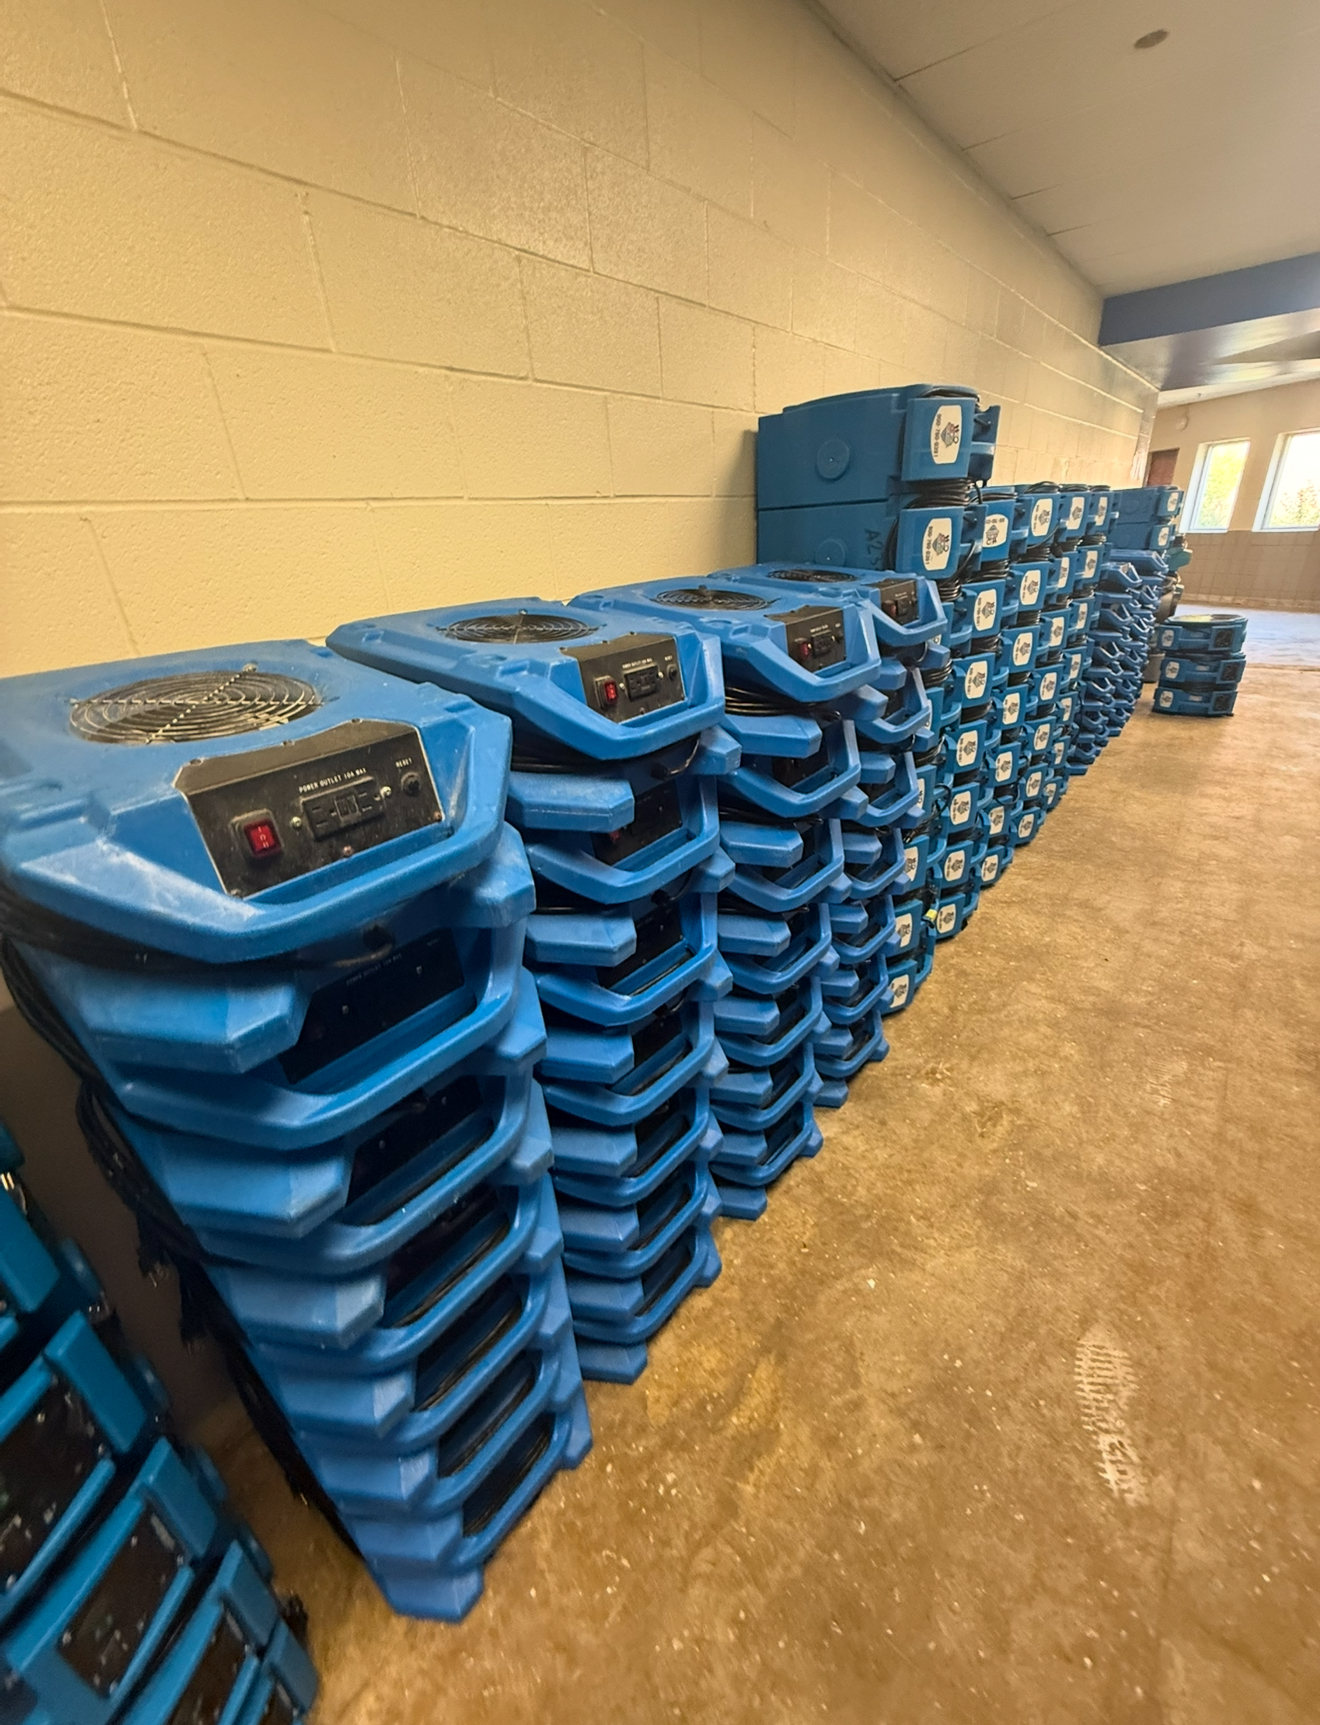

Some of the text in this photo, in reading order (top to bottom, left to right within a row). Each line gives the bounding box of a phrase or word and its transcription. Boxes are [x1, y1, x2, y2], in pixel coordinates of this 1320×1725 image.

[395, 757, 413, 769] RESET
[298, 782, 319, 793] POWER
[319, 775, 342, 787] OUTLET
[355, 767, 367, 777] MAX
